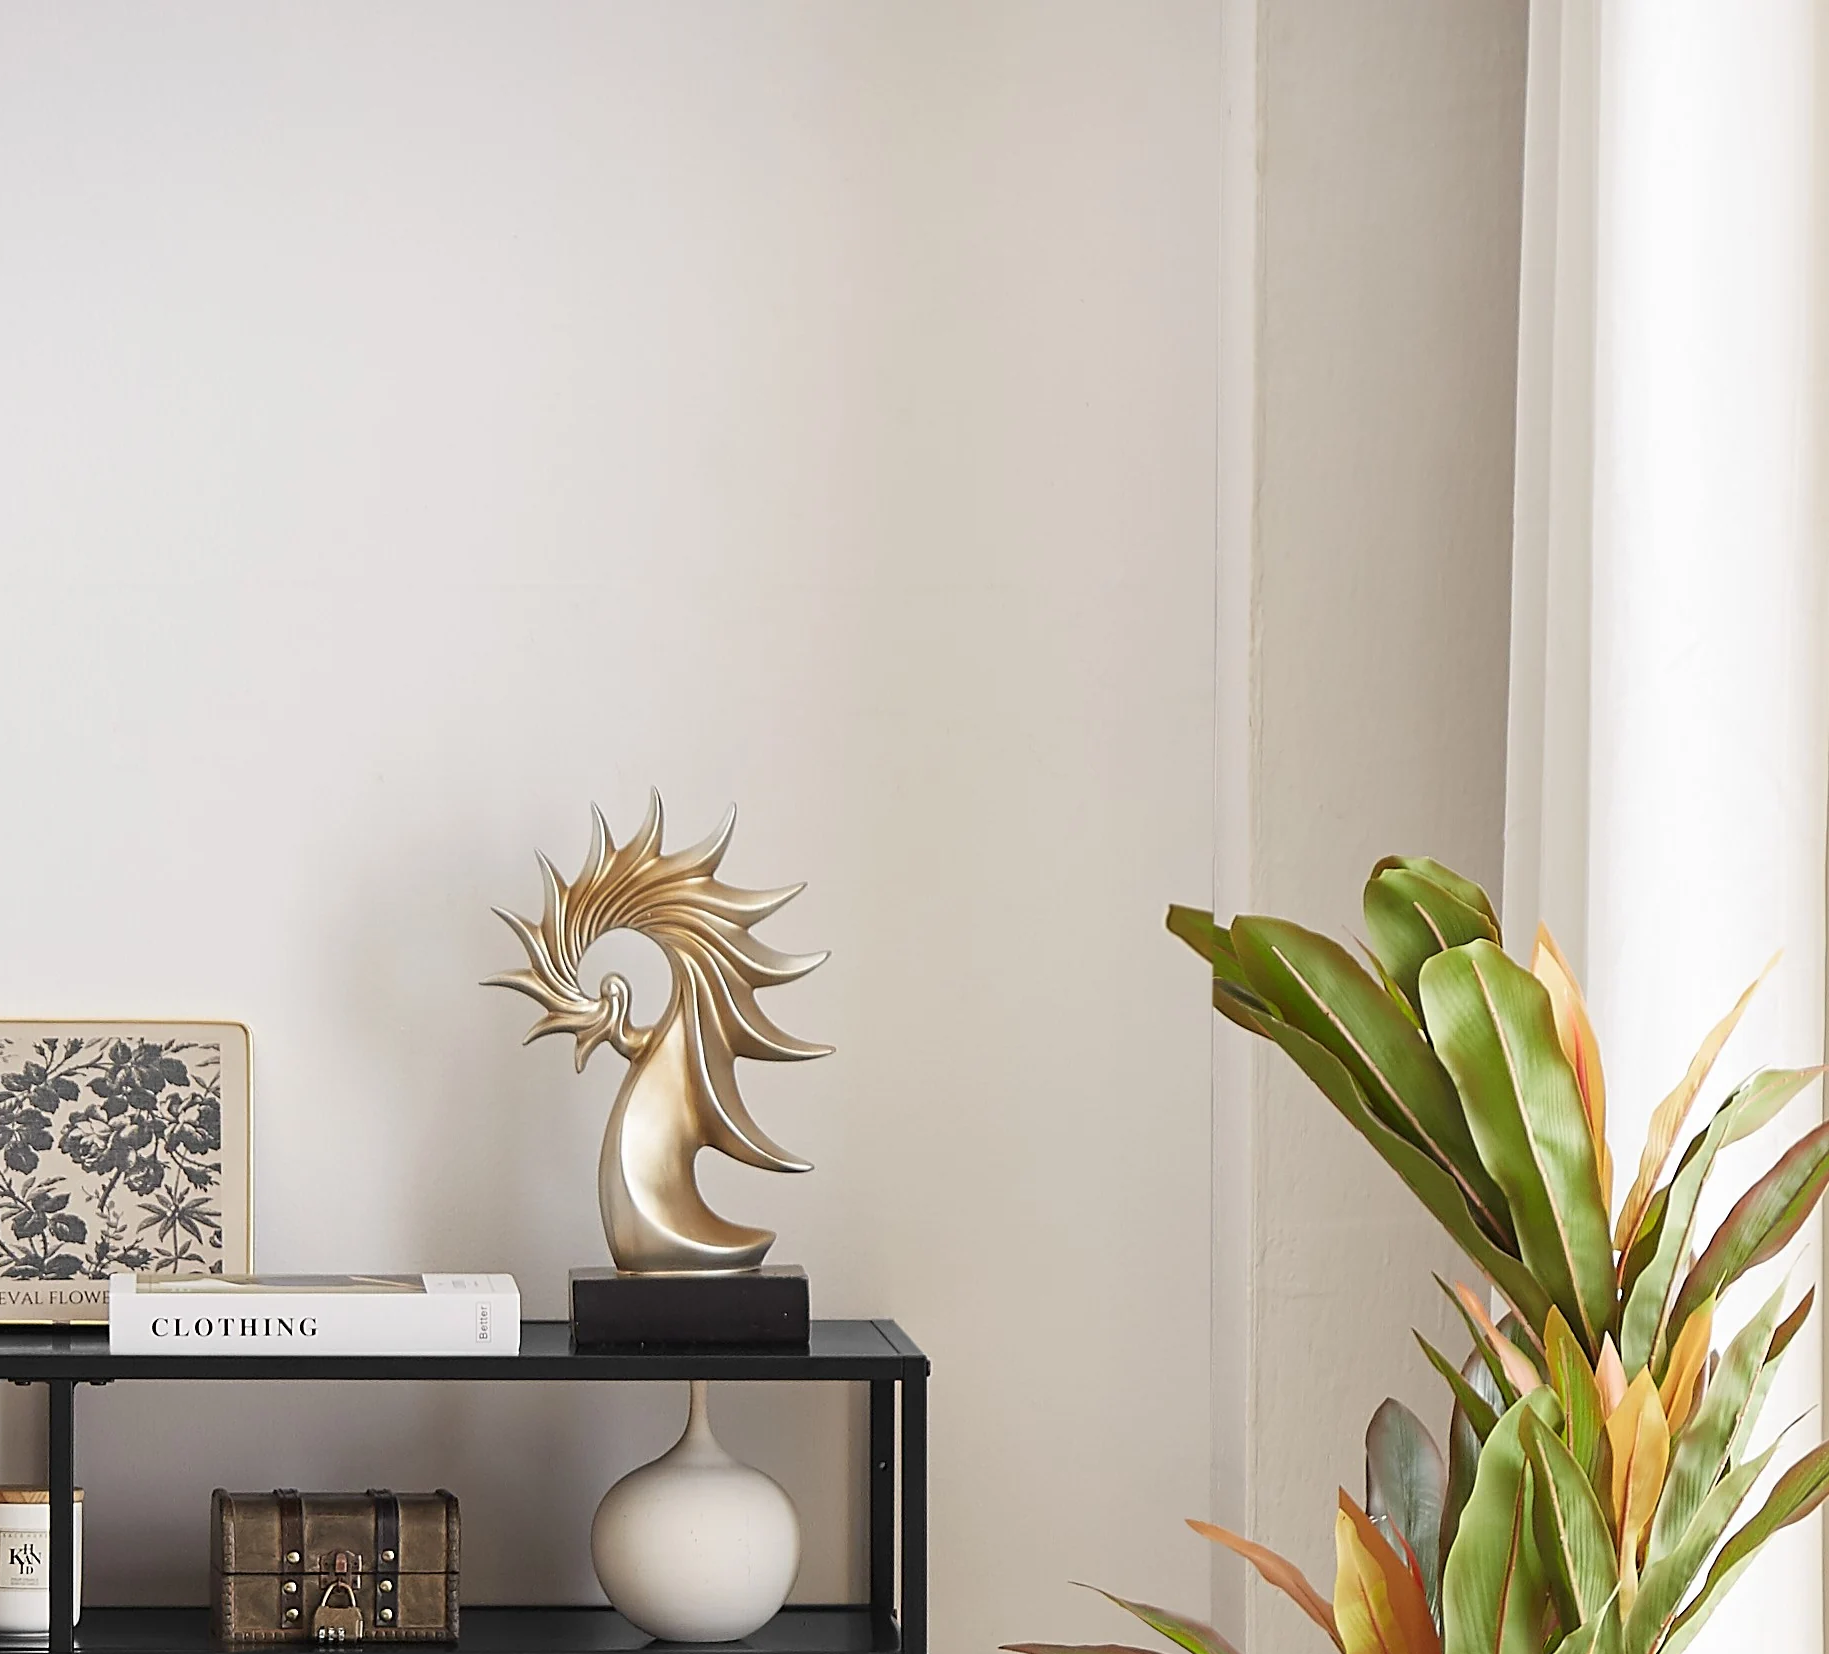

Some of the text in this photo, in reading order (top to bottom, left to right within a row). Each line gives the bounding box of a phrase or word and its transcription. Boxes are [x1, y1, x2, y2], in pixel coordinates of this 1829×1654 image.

[49, 1290, 110, 1305] FLOWE
[151, 1317, 319, 1338] CLOTHING
[479, 1305, 488, 1340] Better
